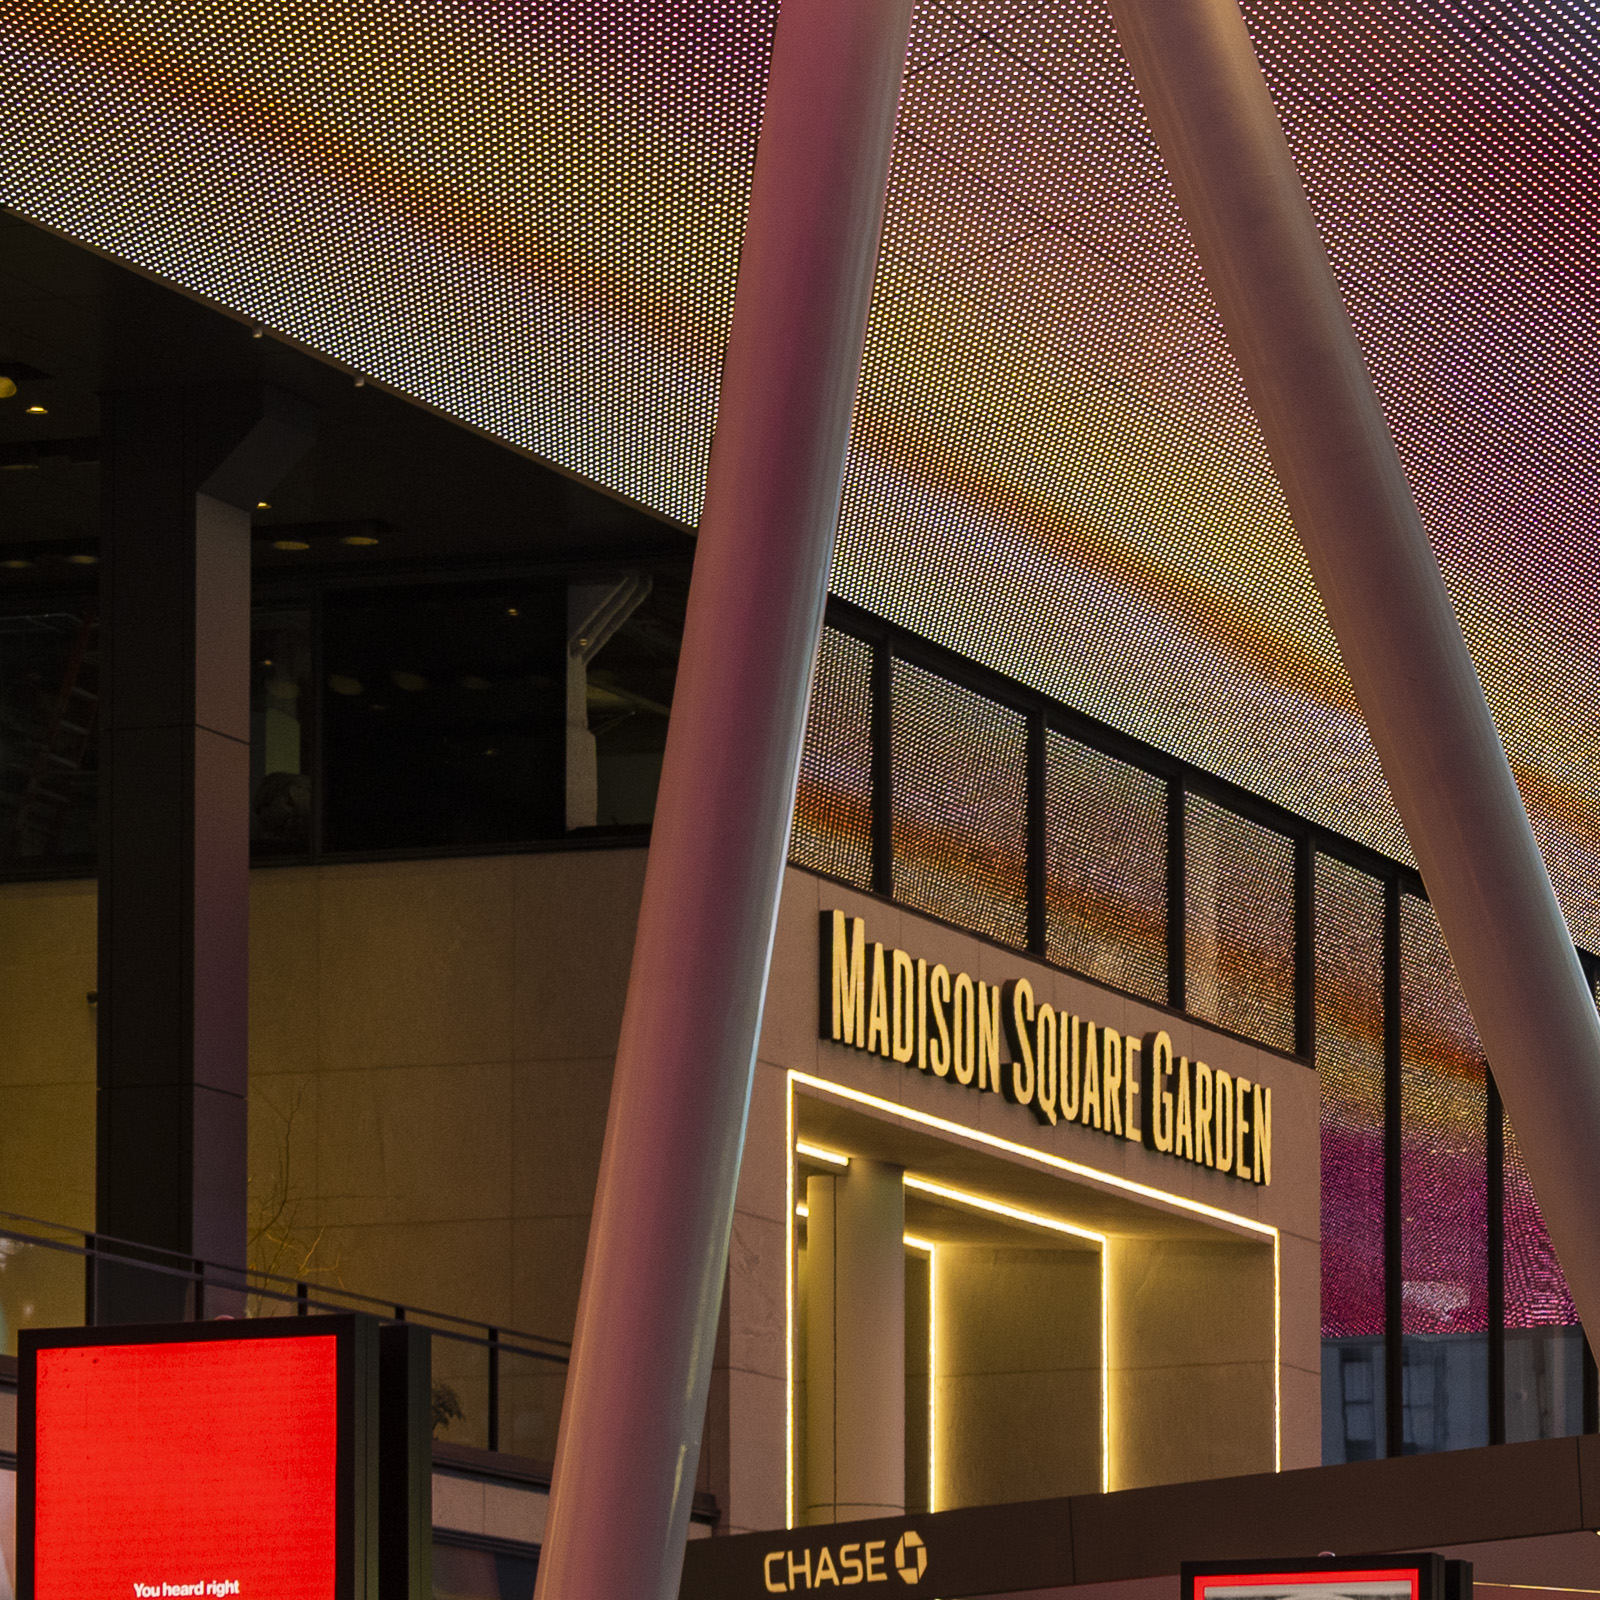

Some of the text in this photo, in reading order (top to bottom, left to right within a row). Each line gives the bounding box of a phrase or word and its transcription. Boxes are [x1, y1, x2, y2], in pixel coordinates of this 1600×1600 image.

[832, 909, 1272, 1187] MADISON SQUARE GARDEN
[133, 1579, 240, 1598] You heard right
[763, 1540, 888, 1593] CHASE
